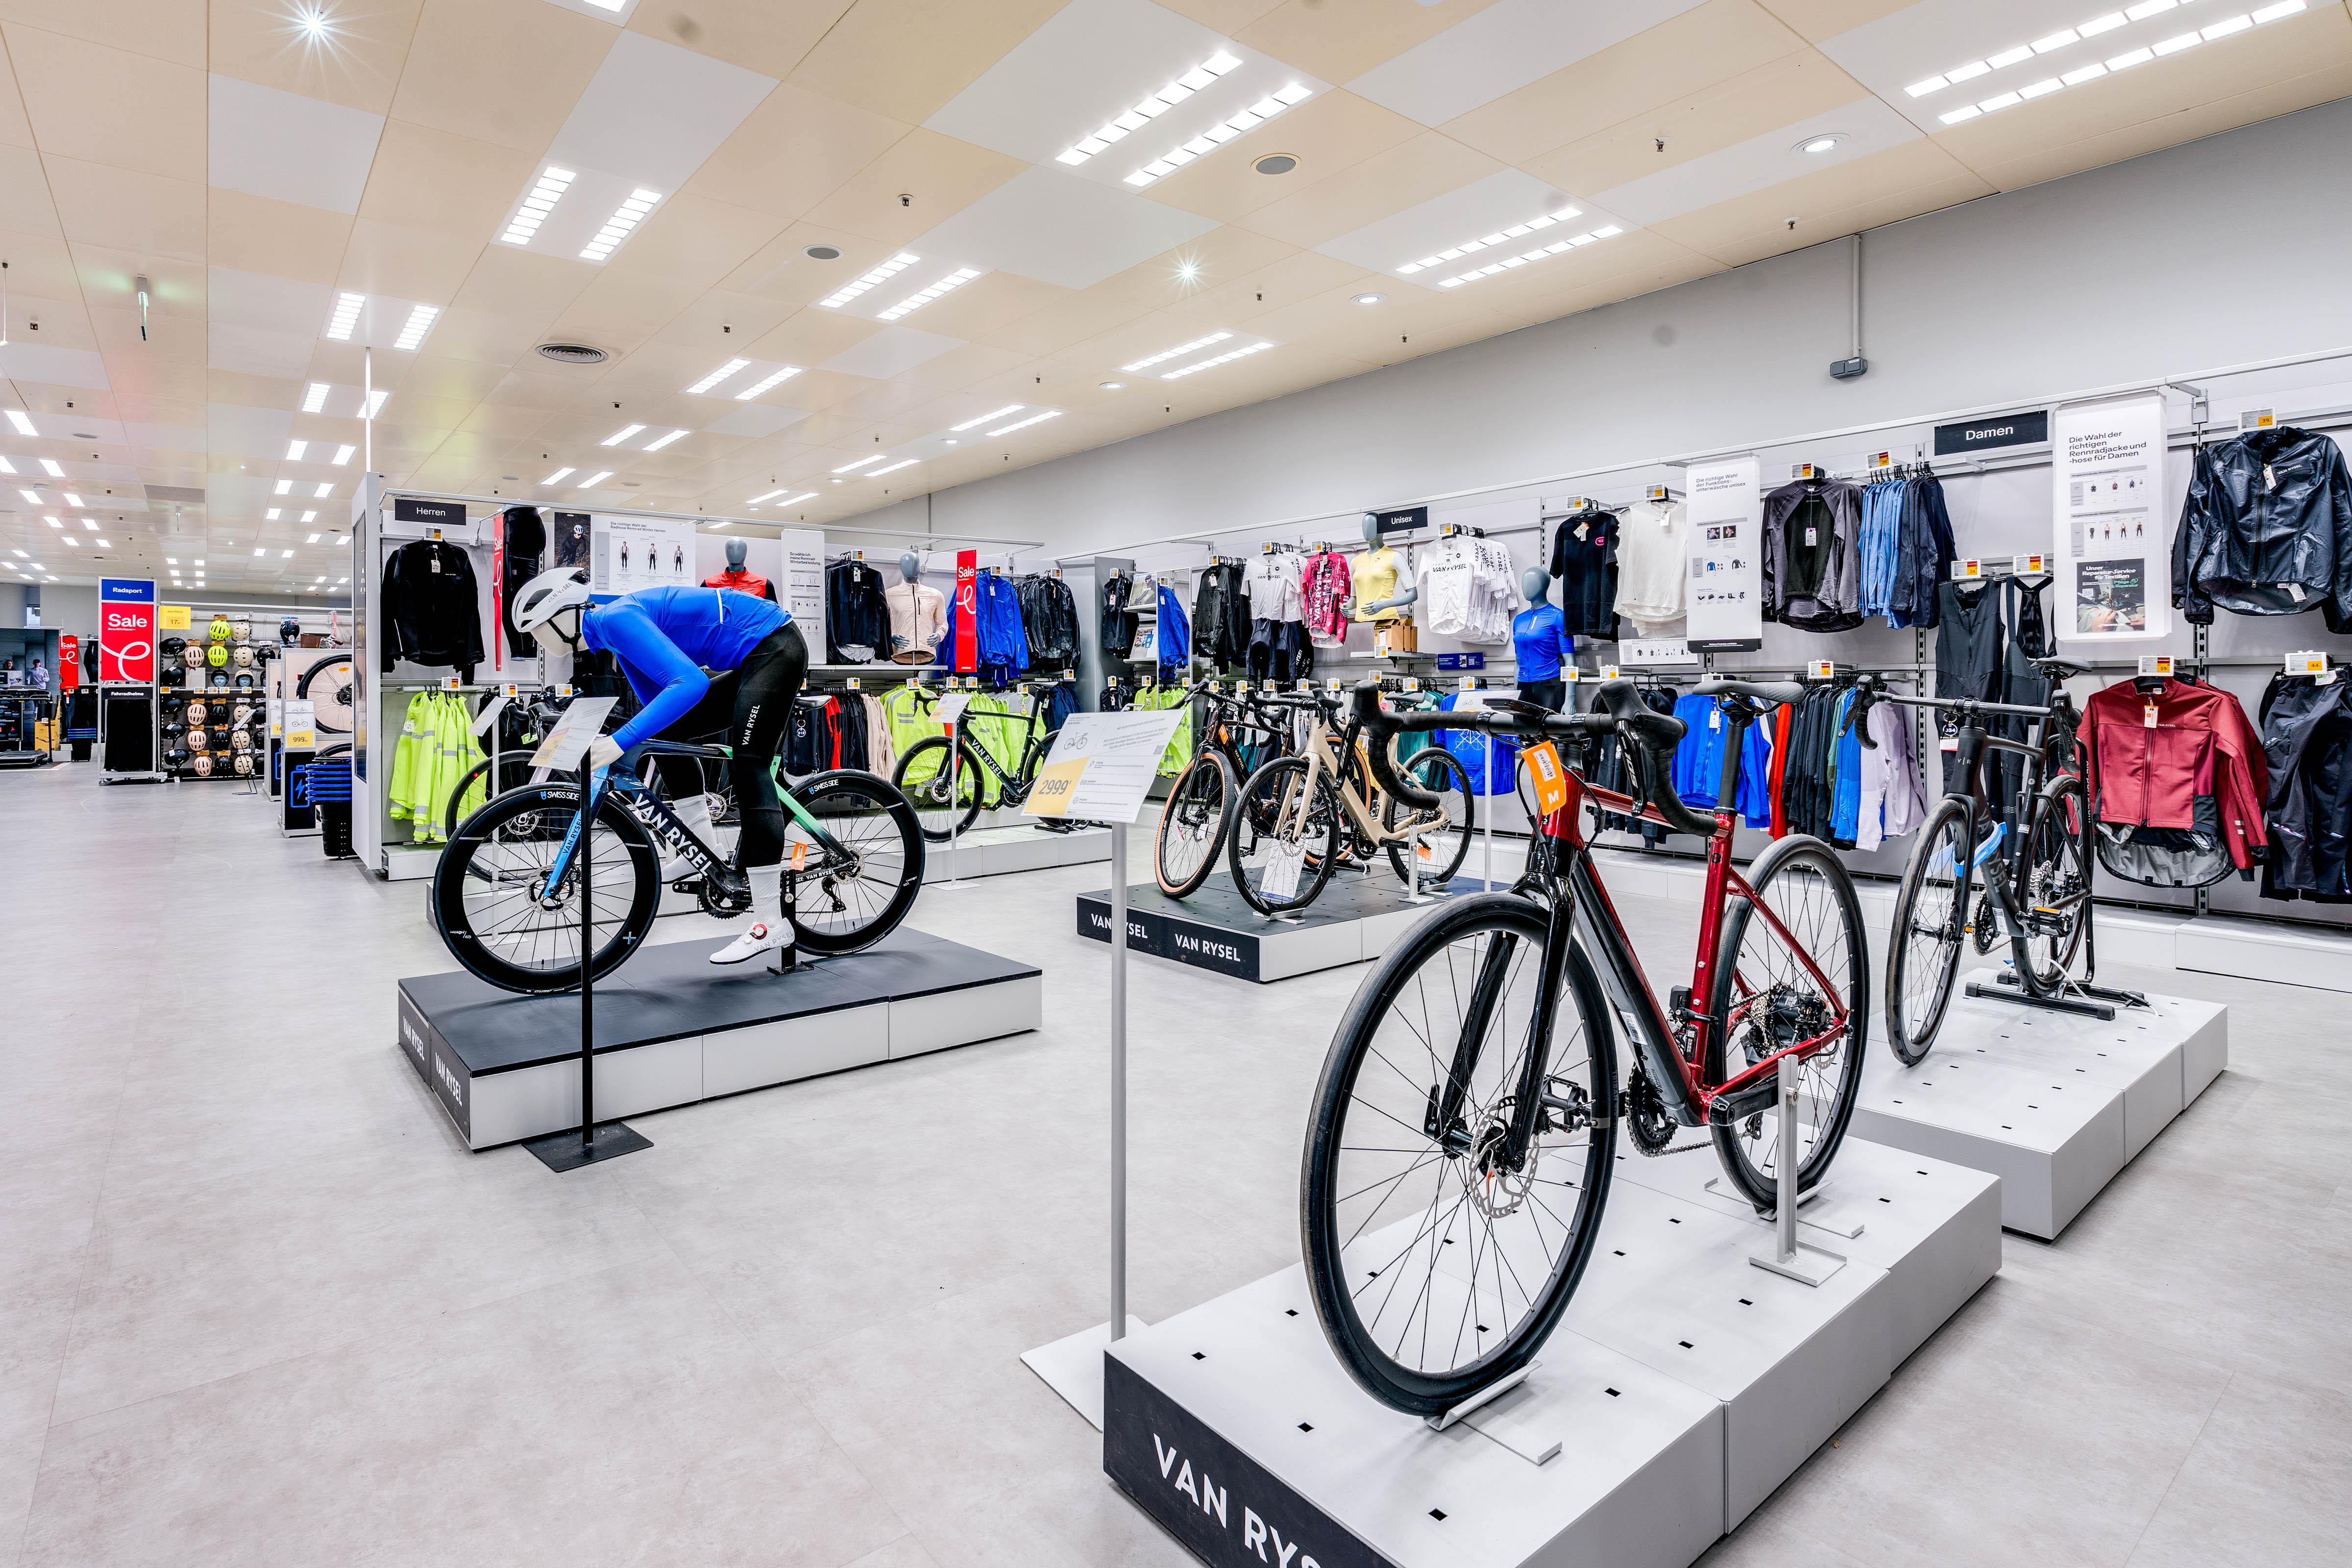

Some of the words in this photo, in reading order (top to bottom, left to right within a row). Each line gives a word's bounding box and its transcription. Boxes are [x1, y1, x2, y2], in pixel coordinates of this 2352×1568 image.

[1966, 426, 2013, 441] Damen
[2084, 433, 2106, 441] Wahl
[2069, 441, 2107, 451] richtigen
[2069, 444, 2129, 457] Rennradjacke
[2069, 455, 2092, 464] -hose
[2107, 451, 2139, 459] Damen
[416, 507, 446, 516] Herren
[1391, 516, 1412, 524] Unisex
[494, 536, 502, 551] Sale
[958, 566, 975, 578] Sale
[108, 613, 147, 627] Sale
[746, 705, 760, 728] RYSEL
[742, 730, 751, 745] VAN
[972, 739, 986, 757] VAN
[983, 755, 1003, 778] RYSEL
[1626, 752, 1638, 788] 105
[814, 782, 828, 792] SWISS
[1547, 790, 1559, 804] M
[635, 793, 669, 829] VAN
[665, 826, 712, 877] RYSEL
[563, 840, 573, 854] VAN
[1091, 913, 1111, 930] VAN
[754, 942, 771, 952] VAN
[1175, 933, 1199, 952] VAN
[1202, 940, 1240, 962] RYSEL
[403, 1016, 412, 1041] VAN
[412, 1029, 425, 1061] RYSEL
[435, 1052, 445, 1082] VAN
[446, 1067, 462, 1106] RYSEL
[1153, 1432, 1227, 1529] VAN
[1244, 1506, 1323, 1568] RY
